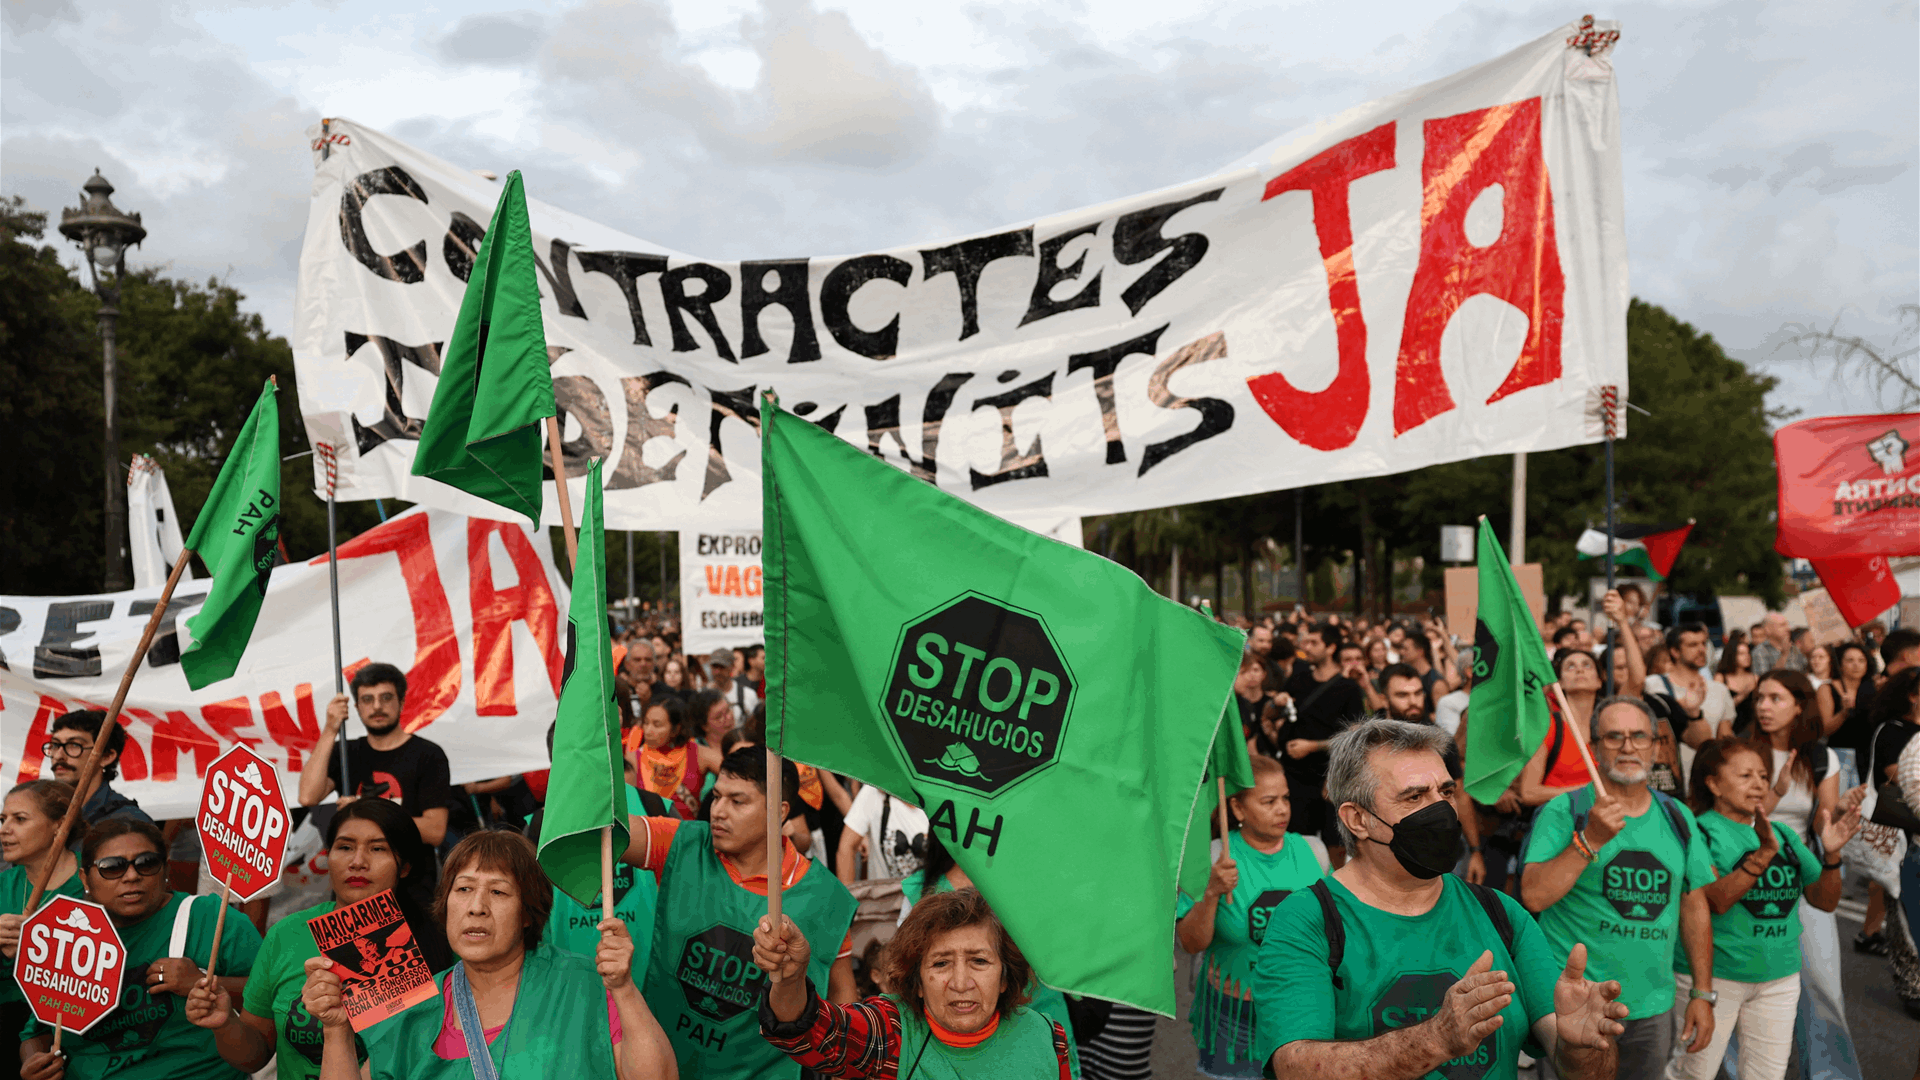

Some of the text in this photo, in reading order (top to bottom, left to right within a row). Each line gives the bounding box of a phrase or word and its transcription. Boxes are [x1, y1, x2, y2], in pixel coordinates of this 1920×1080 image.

[1246, 96, 1566, 451] JA
[233, 489, 275, 536] PAH
[309, 512, 562, 735] JA
[907, 632, 1060, 720] STOP
[895, 692, 1044, 759] DESAHUCIOS
[208, 770, 284, 850] STOP
[202, 812, 273, 877] DESAHUCIOS
[212, 849, 252, 883] PAH BCN
[1607, 865, 1668, 891] STOP
[1607, 888, 1667, 904] DESAHUCIOS
[309, 892, 402, 945] MARICARMEN
[570, 915, 600, 929] PAH
[1600, 920, 1668, 940] PAH BCN
[1753, 924, 1787, 938] PAH
[27, 923, 119, 982] STOP
[318, 942, 331, 951] NI
[334, 932, 361, 946] UNA
[24, 964, 110, 1006] DESAHUCIOS
[687, 941, 762, 986] STOP
[39, 995, 86, 1017] PAH BCN
[343, 964, 429, 1008] PALAU DE CONGRESSOS
[681, 967, 753, 1006] DESAHUCIOS
[676, 1013, 727, 1052] PAH
